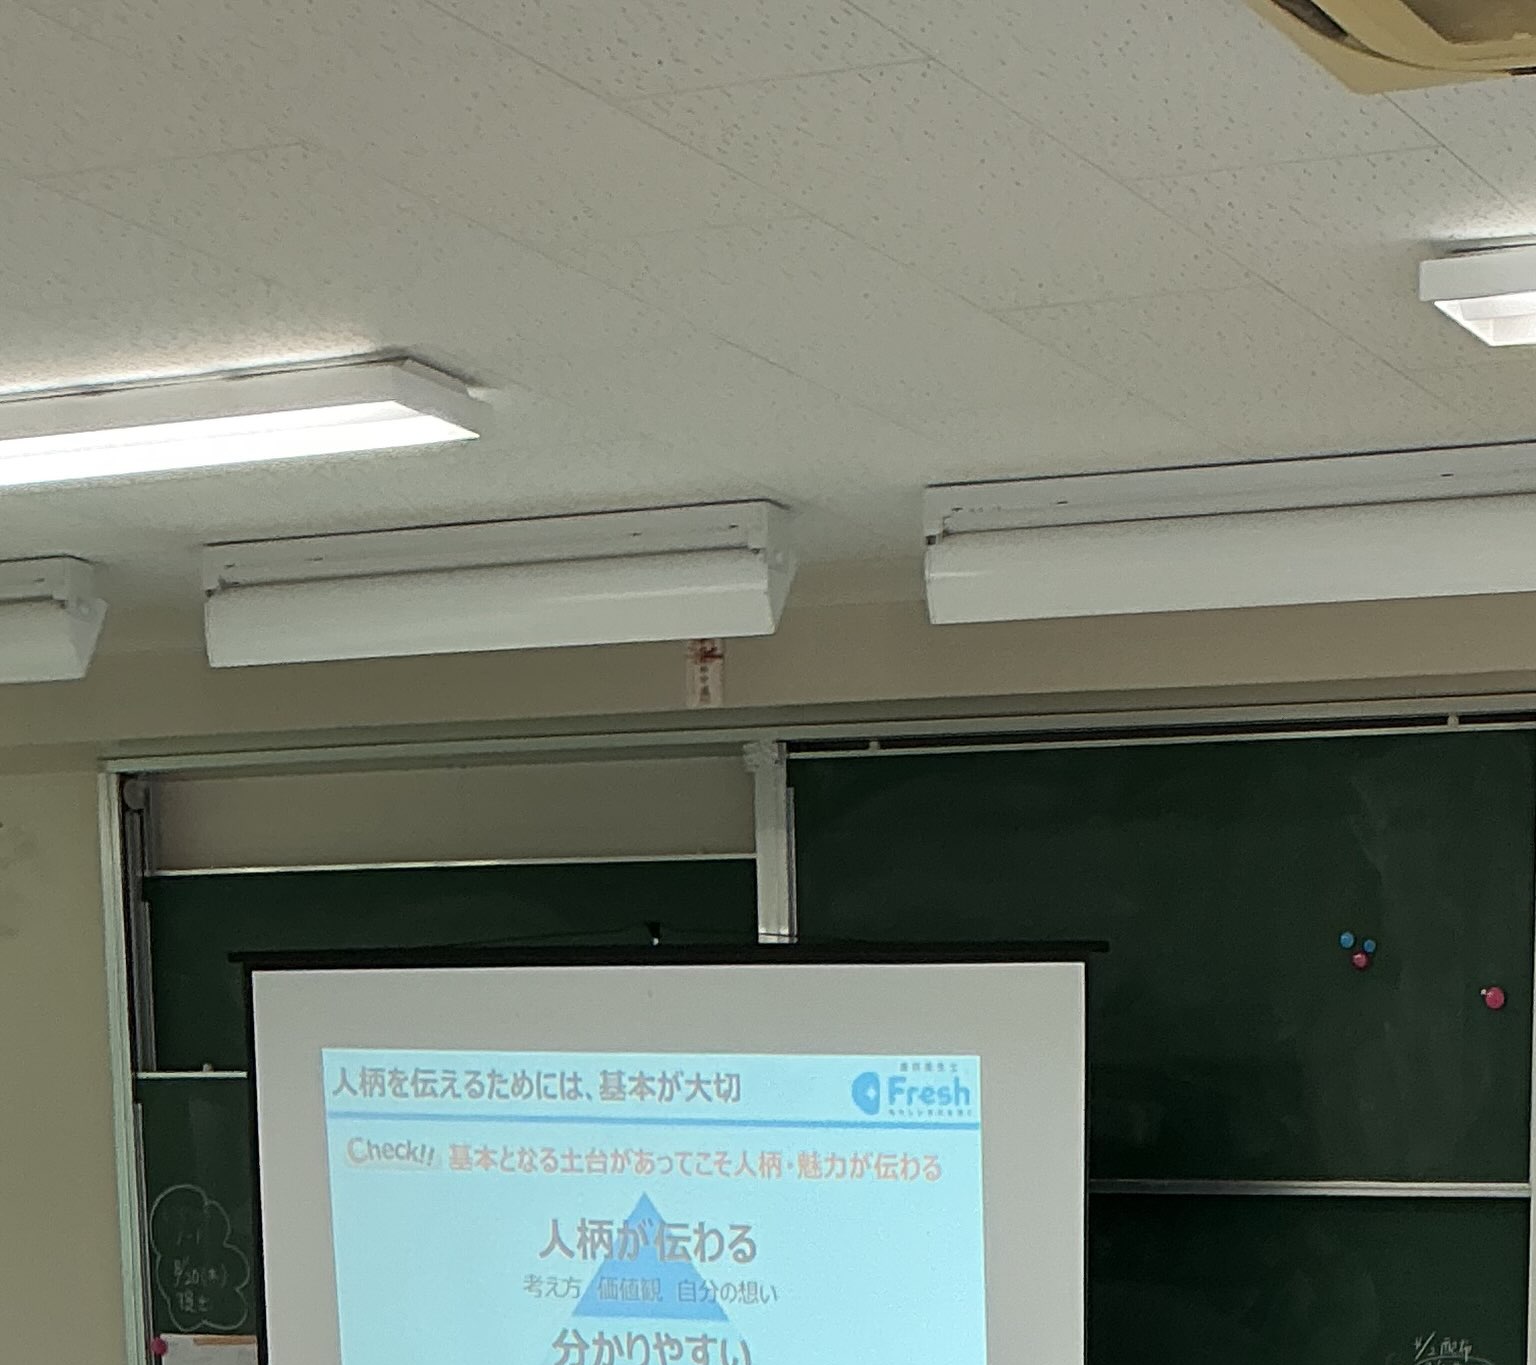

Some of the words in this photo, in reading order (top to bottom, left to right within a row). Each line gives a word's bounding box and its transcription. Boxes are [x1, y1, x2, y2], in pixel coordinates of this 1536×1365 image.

[332, 1066, 741, 1103] 人柄を伝えるためには、基本が大切
[888, 1076, 970, 1106] Fresh
[347, 1137, 436, 1168] Check!!
[449, 1142, 942, 1181] 基本となる土台があってこそ人柄・魅力が伝わる
[538, 1217, 758, 1264] 人柄が伝わる
[523, 1273, 582, 1299] 考え方
[597, 1276, 663, 1302] 価値観
[677, 1278, 778, 1304] 自分の想い
